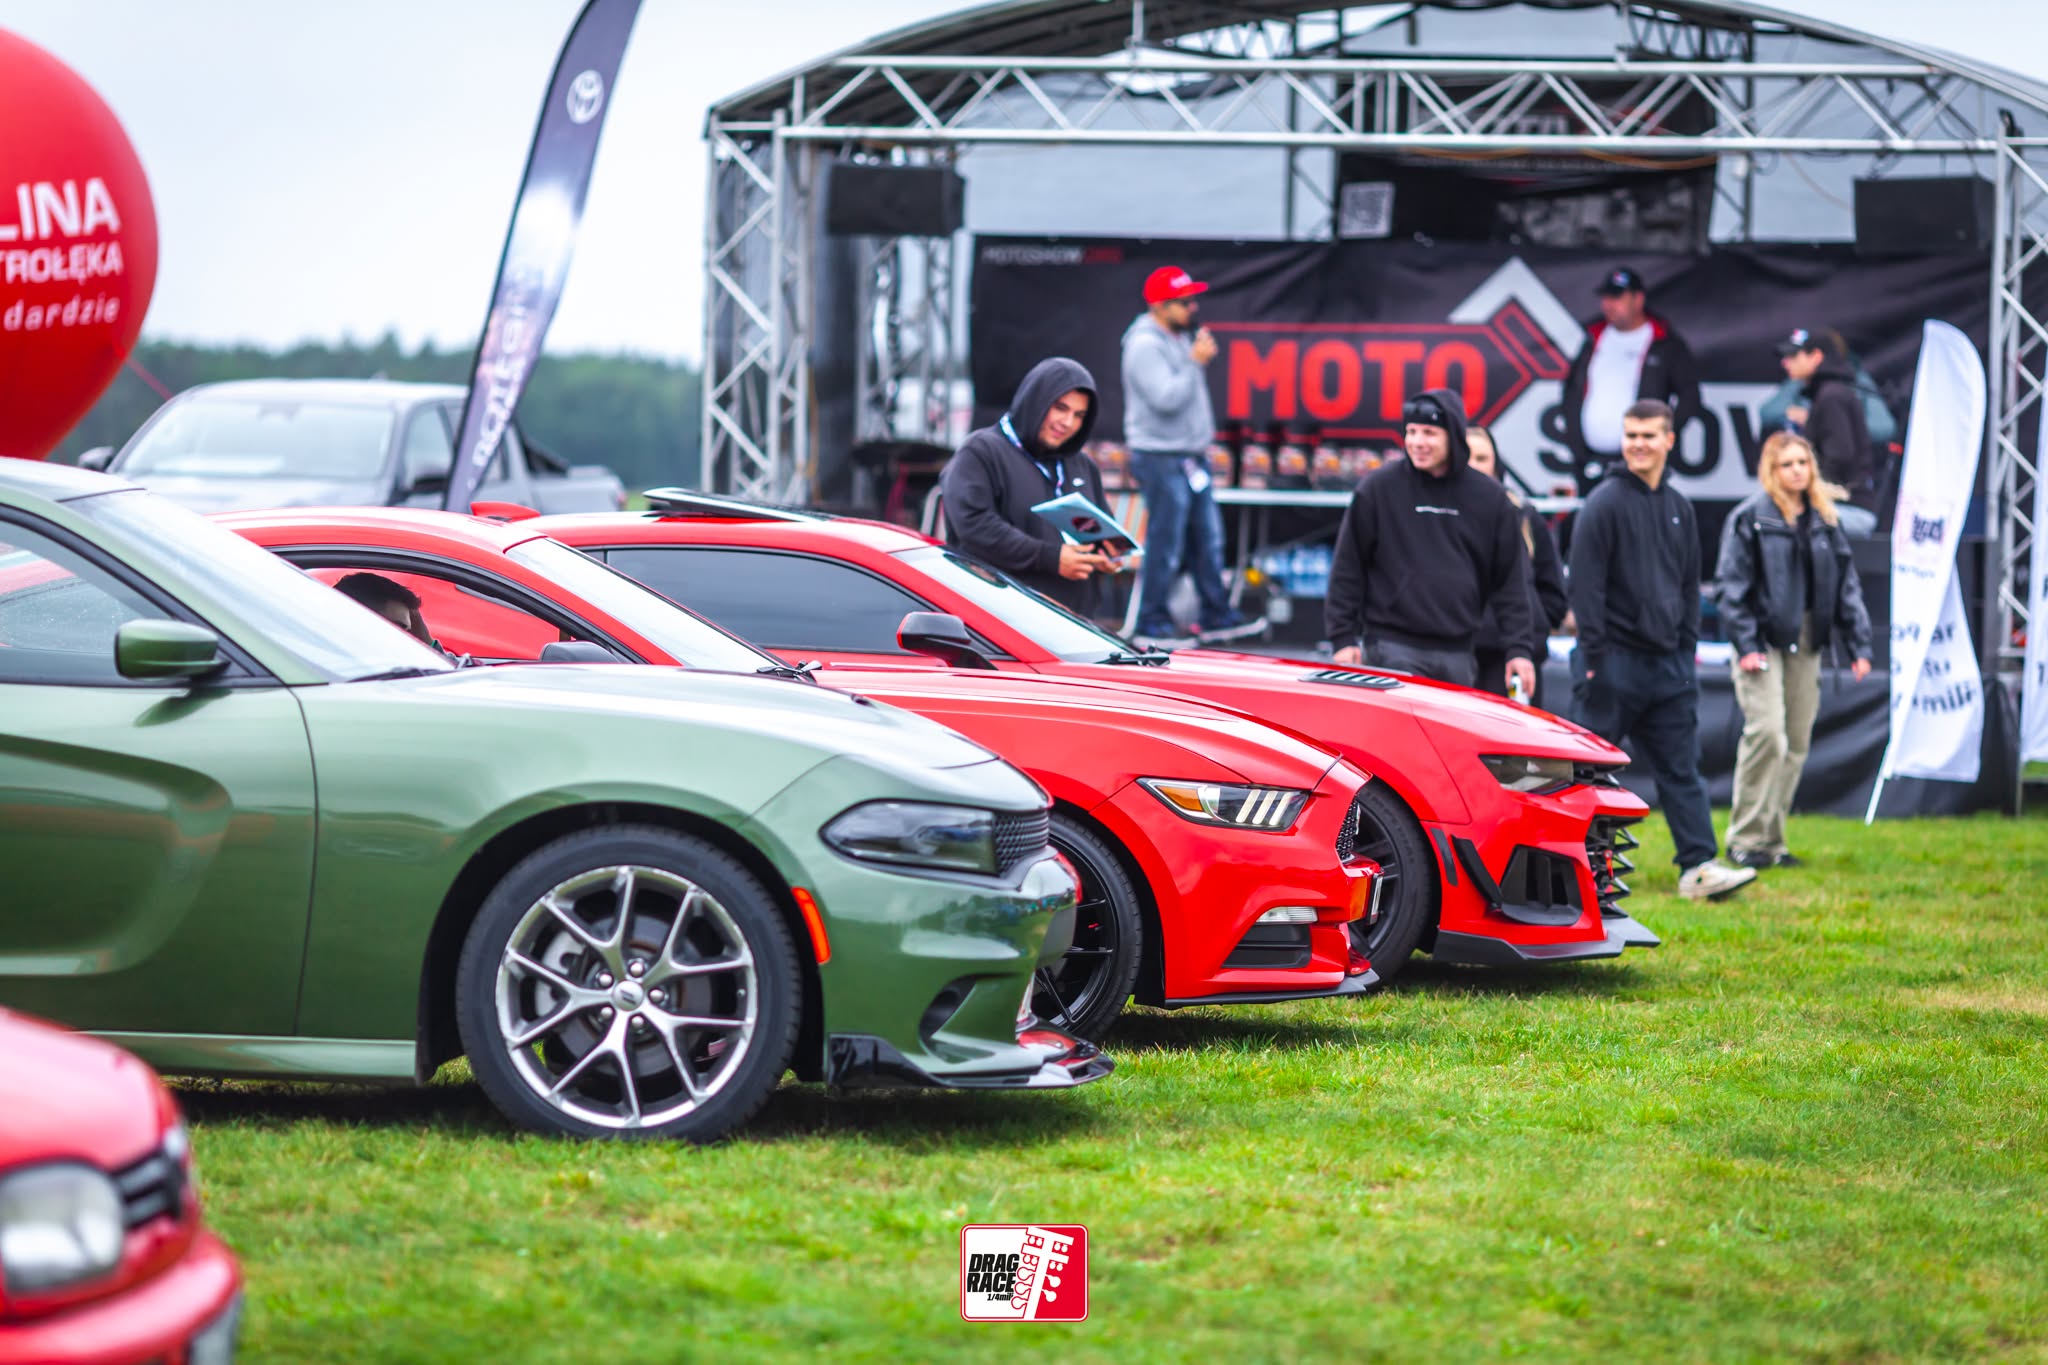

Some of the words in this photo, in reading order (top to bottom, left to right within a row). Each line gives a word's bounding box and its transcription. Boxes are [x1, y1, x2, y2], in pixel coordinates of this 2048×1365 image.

[0, 241, 124, 286] ROŁĘKA
[3, 291, 121, 331] dardzie
[1226, 338, 1487, 422] MOTO
